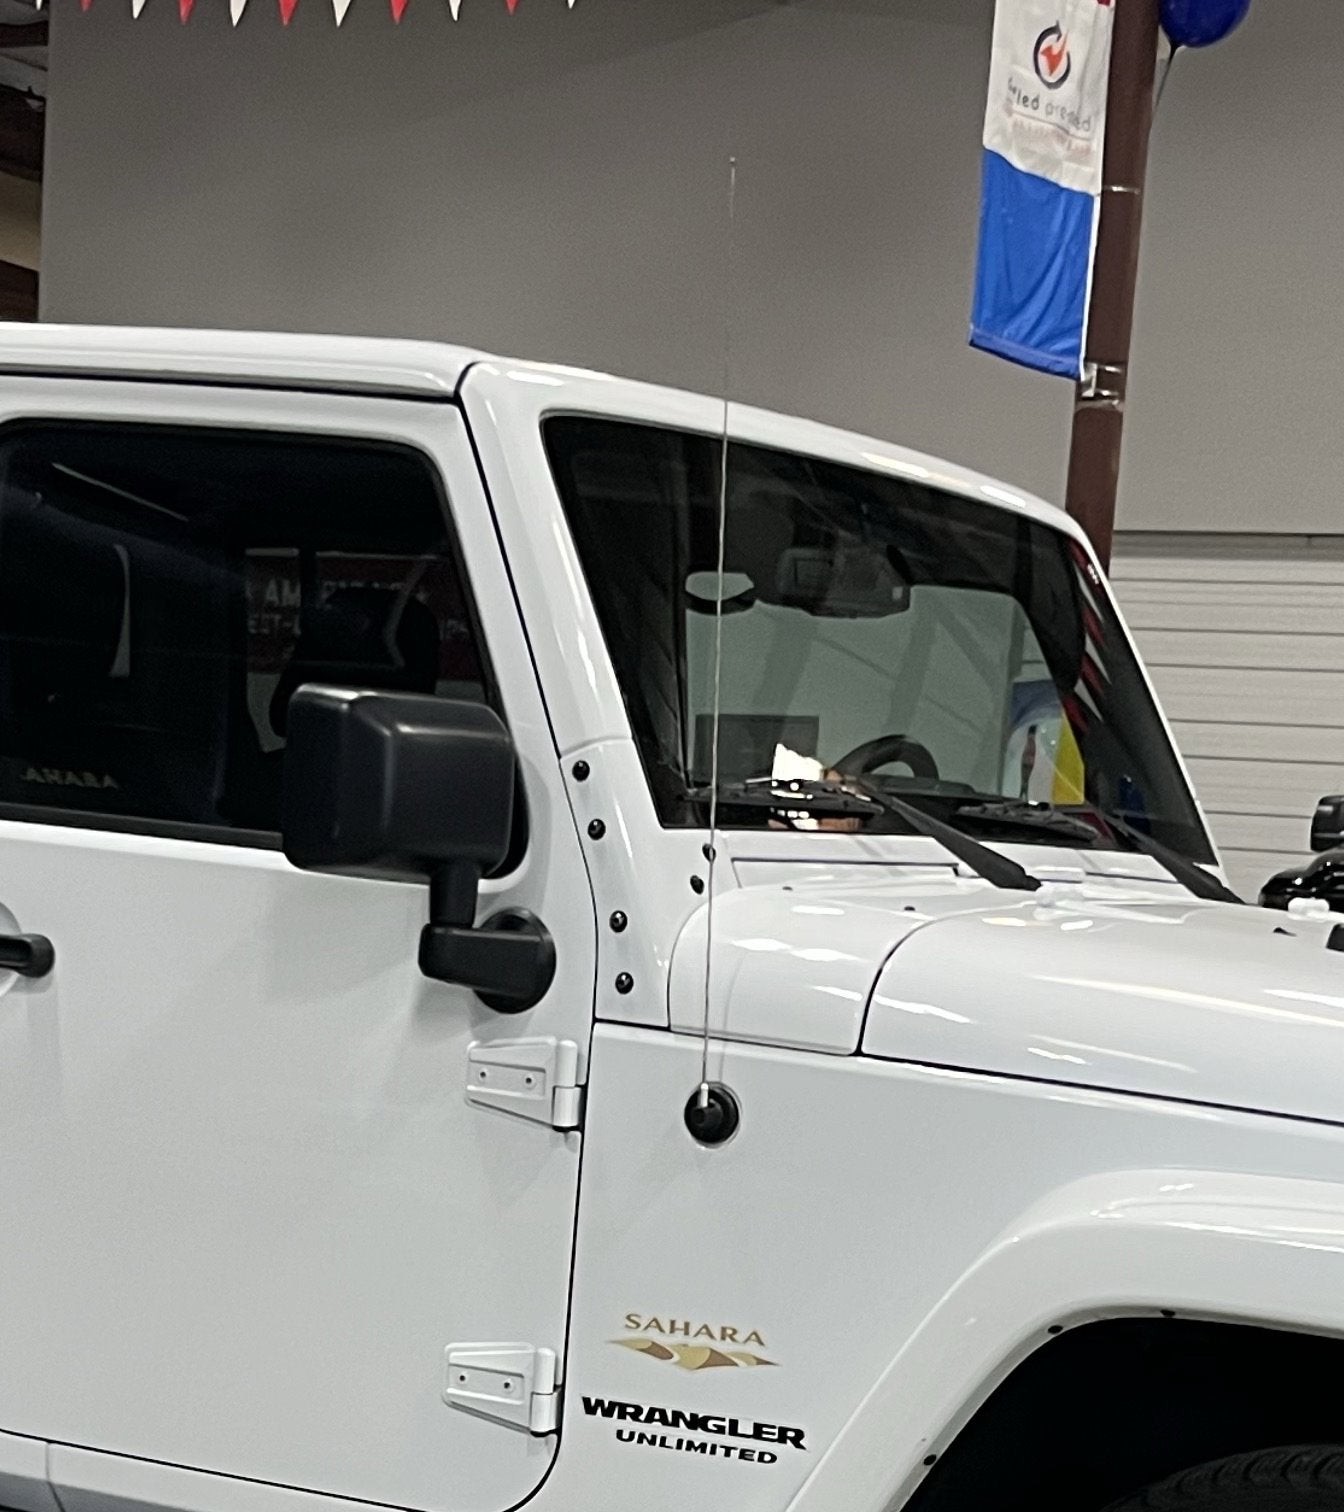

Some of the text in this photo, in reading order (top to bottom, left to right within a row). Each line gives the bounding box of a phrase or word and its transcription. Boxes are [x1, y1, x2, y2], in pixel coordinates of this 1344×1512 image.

[625, 1313, 766, 1347] SAHARA
[581, 1396, 808, 1451] WRANGLER
[615, 1429, 778, 1465] UNLIMITED
